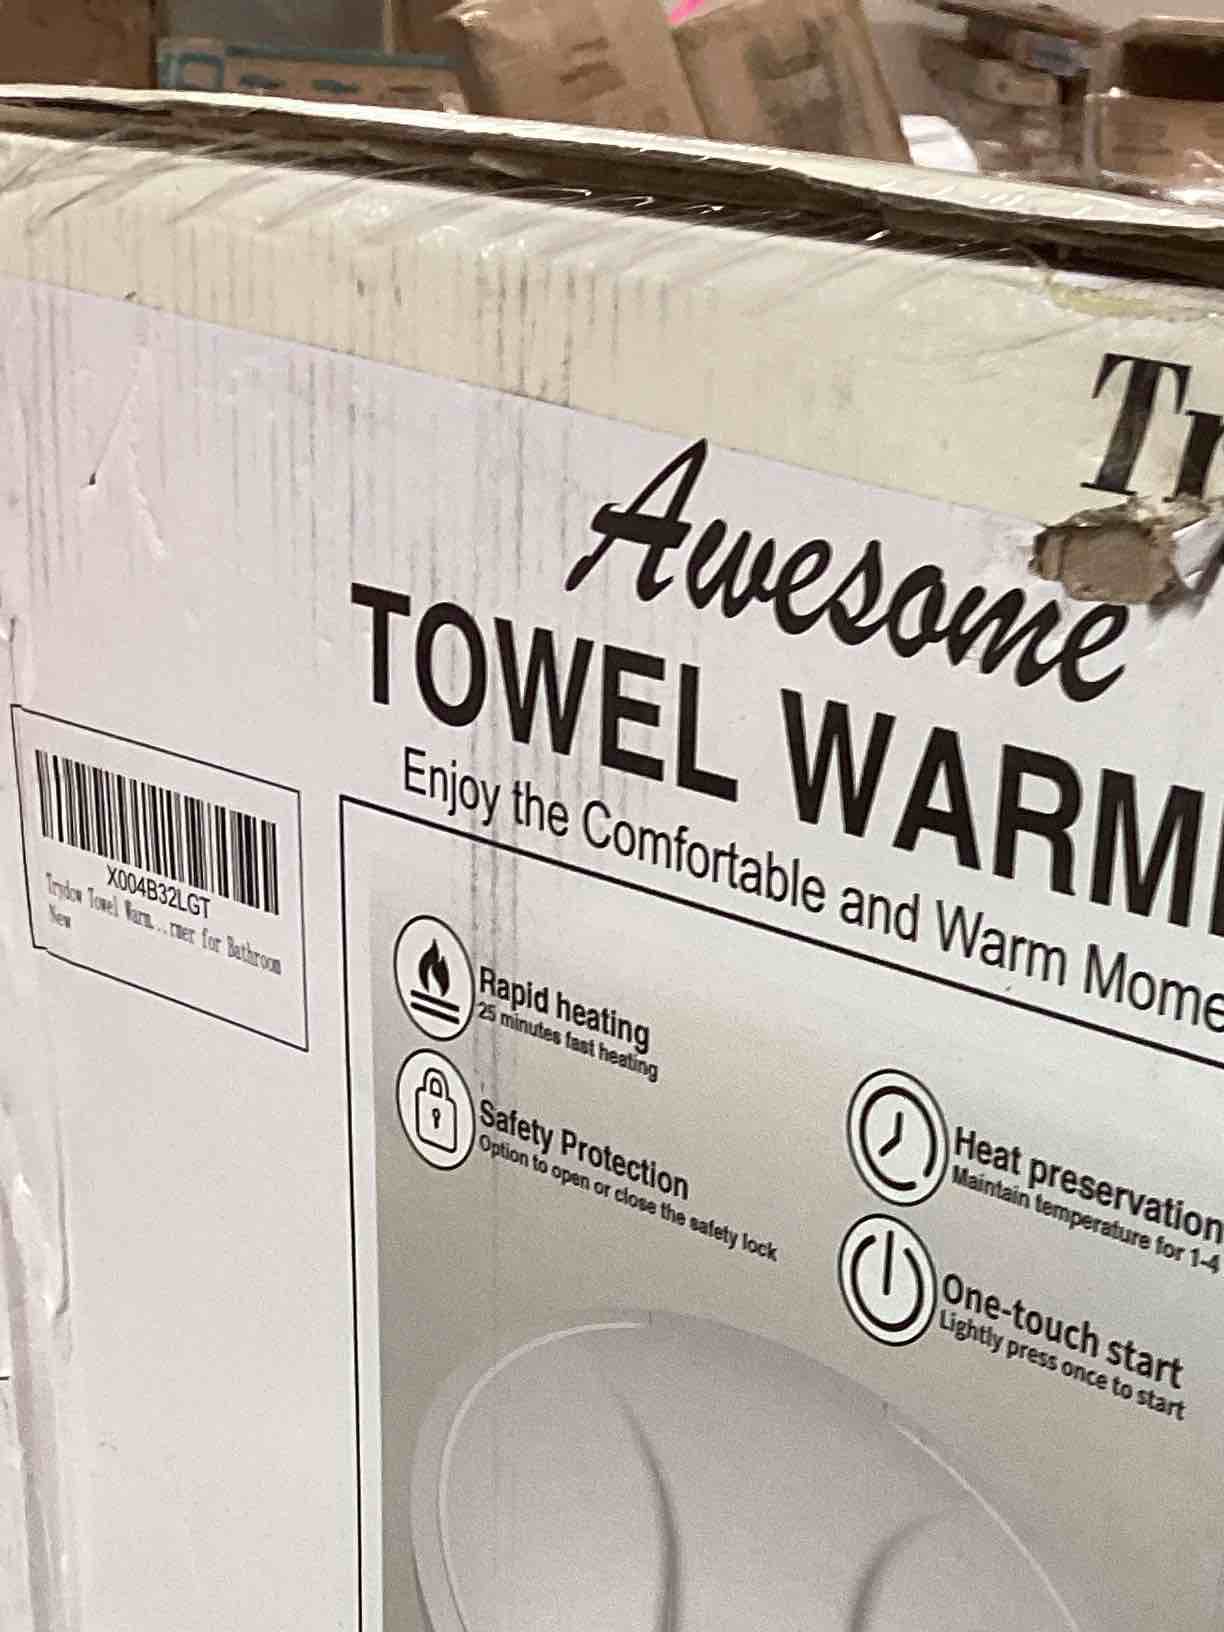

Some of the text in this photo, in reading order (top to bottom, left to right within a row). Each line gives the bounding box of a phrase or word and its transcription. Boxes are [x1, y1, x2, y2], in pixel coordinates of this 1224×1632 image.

[564, 438, 1128, 703] Awesome
[350, 582, 740, 803] TOWEL
[106, 864, 210, 918] X004B32LGT
[404, 746, 500, 826] Enjoy
[512, 780, 568, 836] the
[582, 800, 825, 913] Comfortable
[840, 886, 919, 942] and
[935, 899, 1066, 986] Warm
[479, 966, 649, 1057] Rapid heating
[480, 1000, 658, 1082] 25 minutes fast heating
[479, 1098, 688, 1200] Safety Protection
[479, 1134, 777, 1261] Option to open or close the safety lock
[954, 1126, 1224, 1244] Heat preservation
[951, 1164, 1030, 1208] Maintain
[1034, 1193, 1151, 1249] temperature
[1155, 1235, 1185, 1261] for
[1190, 1247, 1219, 1274] 1-4
[939, 1308, 1185, 1421] Lightly press once to start
[942, 1273, 1183, 1389] One-touch start
